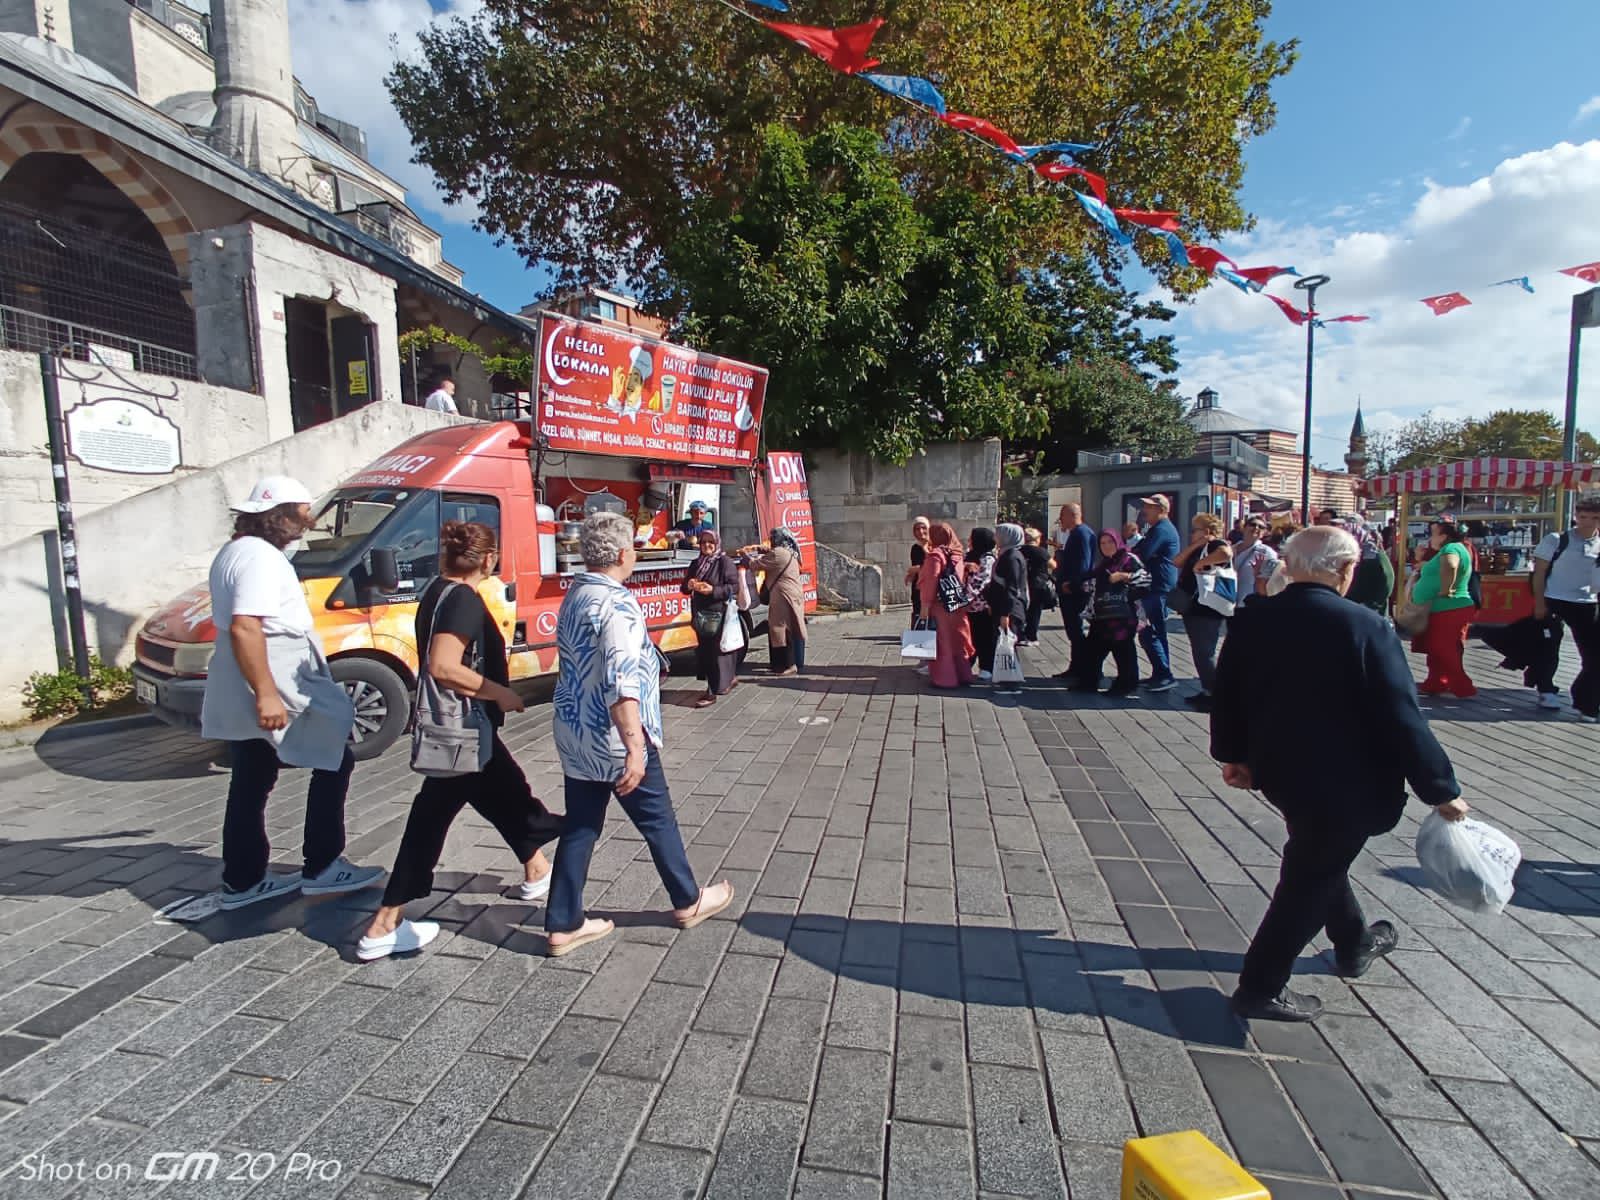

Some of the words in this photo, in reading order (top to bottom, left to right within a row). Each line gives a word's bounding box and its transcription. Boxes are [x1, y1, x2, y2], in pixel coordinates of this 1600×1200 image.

[564, 335, 605, 356] HELAL
[688, 361, 721, 383] LOKMASI
[721, 369, 754, 390] DÖKÜLÜR
[679, 382, 714, 401] TAVUKLU
[677, 402, 707, 420] BARDAK
[708, 407, 732, 423] ÇORBA
[541, 421, 558, 437] ÖZEL
[705, 427, 717, 442] 862
[767, 455, 806, 484] LOK
[641, 601, 662, 619] 862
[665, 599, 679, 616] 96
